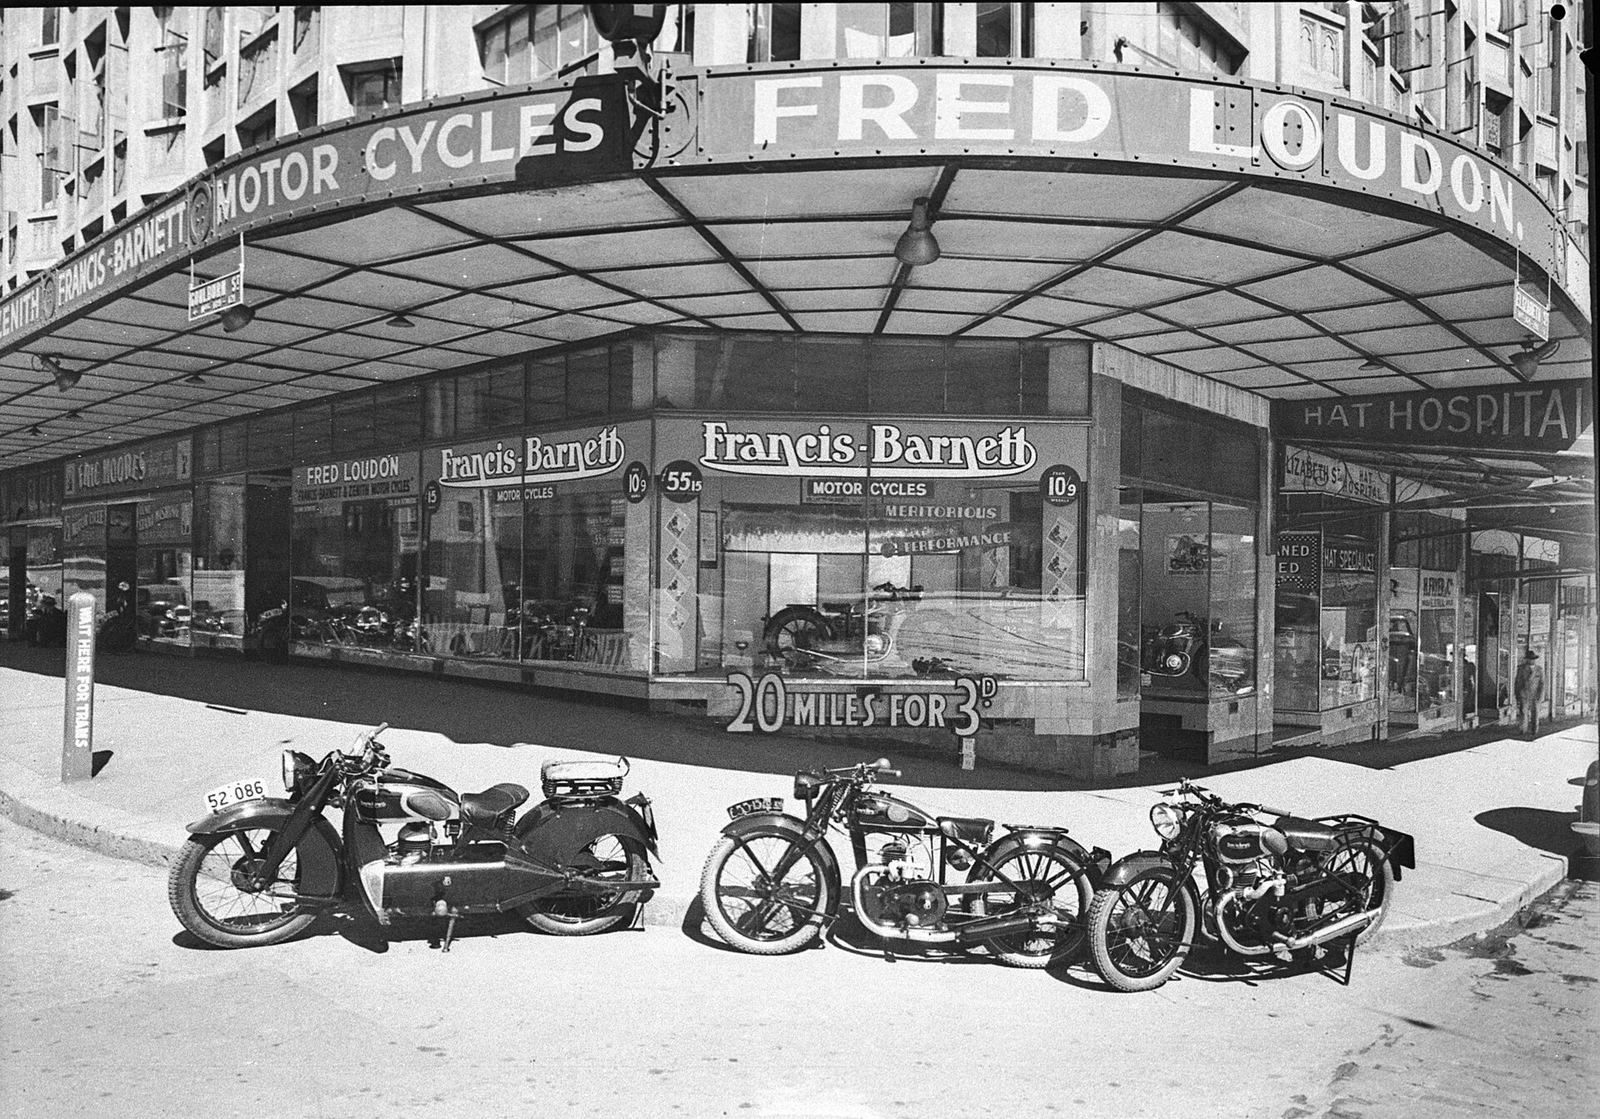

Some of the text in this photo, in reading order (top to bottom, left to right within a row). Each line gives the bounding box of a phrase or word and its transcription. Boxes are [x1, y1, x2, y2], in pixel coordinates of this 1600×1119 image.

[753, 73, 1111, 145] FRED
[0, 287, 40, 338] ENITH
[216, 144, 340, 226] MOTOR
[365, 98, 605, 181] CYCLES
[1304, 402, 1373, 429] HAT
[306, 455, 399, 485] FRED LOUDON
[497, 487, 553, 501] MOTOR CYCLES
[812, 481, 928, 496] MOTOR CYCLES
[885, 504, 997, 519] MERITORIOUS
[904, 531, 1012, 553] PERFORMANCE
[1278, 545, 1310, 557] NED
[74, 606, 93, 748] WAIT HERE FOR TRAMS
[726, 673, 786, 732] 20
[794, 693, 876, 727] MILES
[890, 694, 948, 728] FOR
